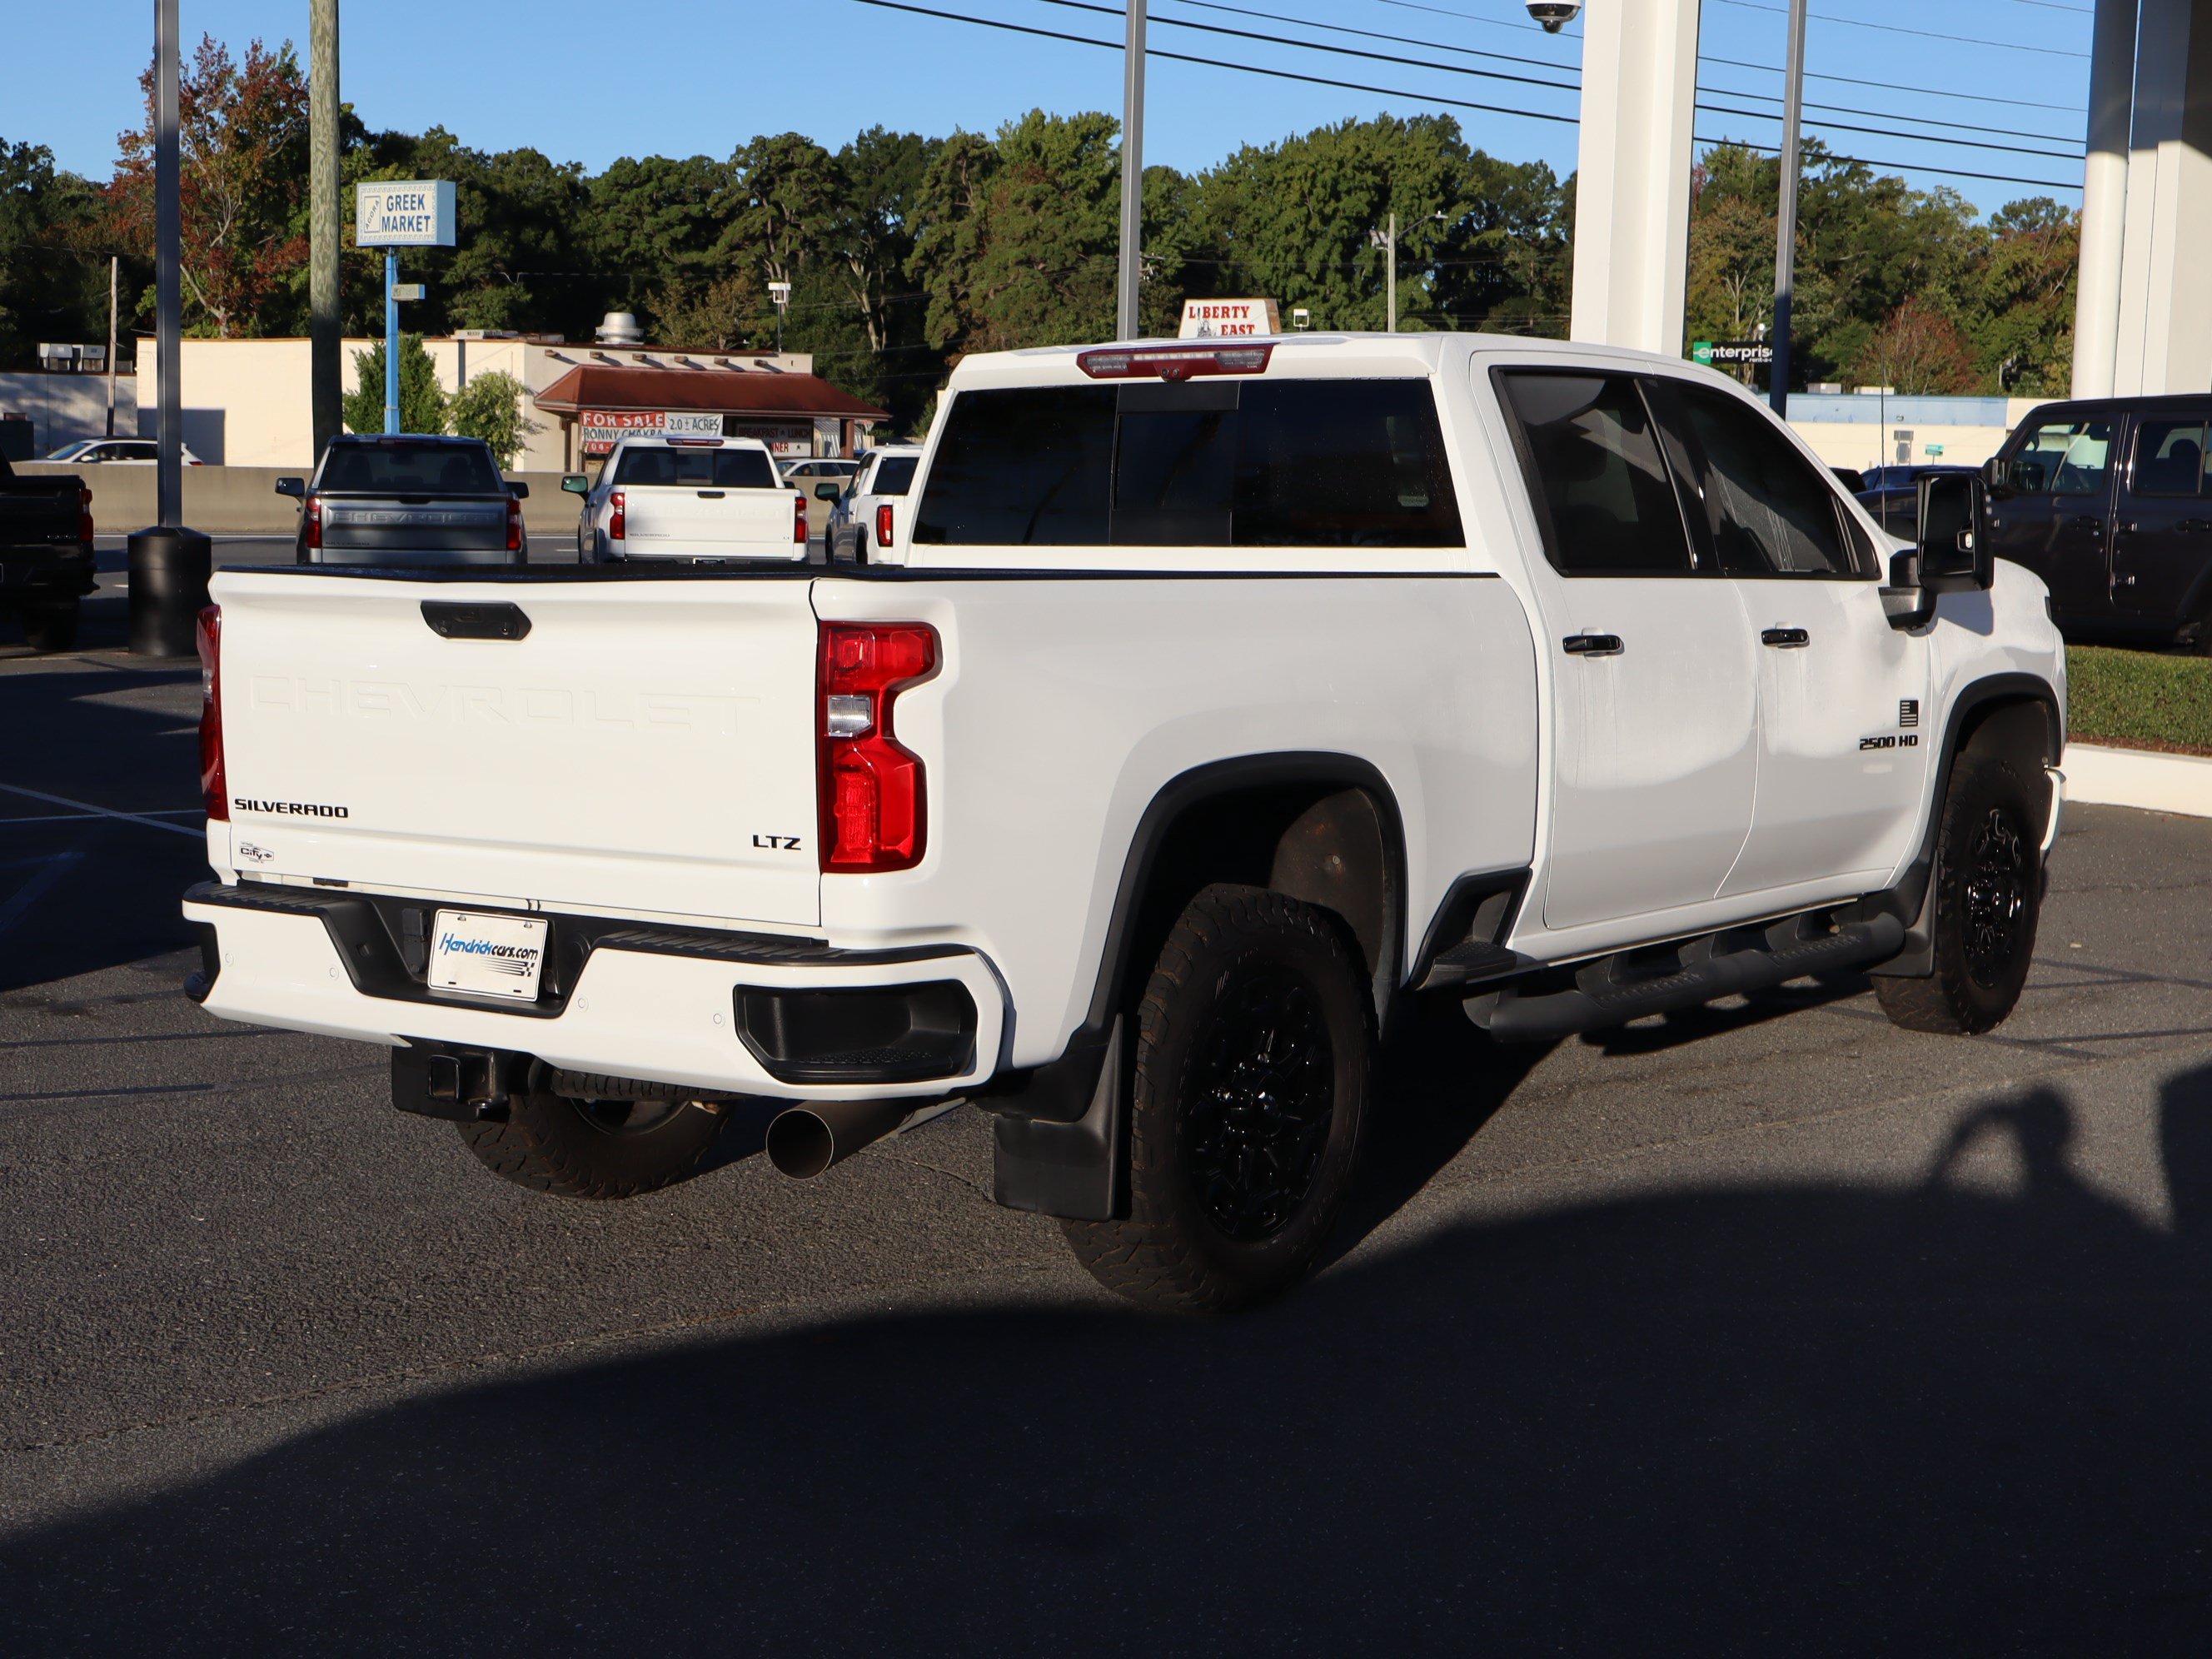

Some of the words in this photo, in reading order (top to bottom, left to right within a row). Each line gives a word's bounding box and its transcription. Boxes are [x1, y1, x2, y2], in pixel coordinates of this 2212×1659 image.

[386, 193, 426, 212] GREEK
[366, 200, 380, 230] AGORA
[381, 215, 431, 232] MARKET
[1188, 306, 1250, 320] LIBERTY
[1221, 324, 1255, 336] EAST
[1693, 344, 1773, 361] enterpris
[584, 413, 617, 426] FOR
[622, 413, 664, 427] SALE
[670, 418, 683, 431] 2.0
[692, 418, 720, 431] ACRES
[584, 427, 620, 441] RONNY
[250, 675, 760, 733] CHEVROLET
[1860, 736, 1896, 750] 2500
[1899, 735, 1918, 747] HD
[234, 798, 349, 818] SILVERADO
[753, 834, 801, 850] LTZ
[240, 847, 263, 859] City
[439, 933, 539, 960] Hendrickcars.com
